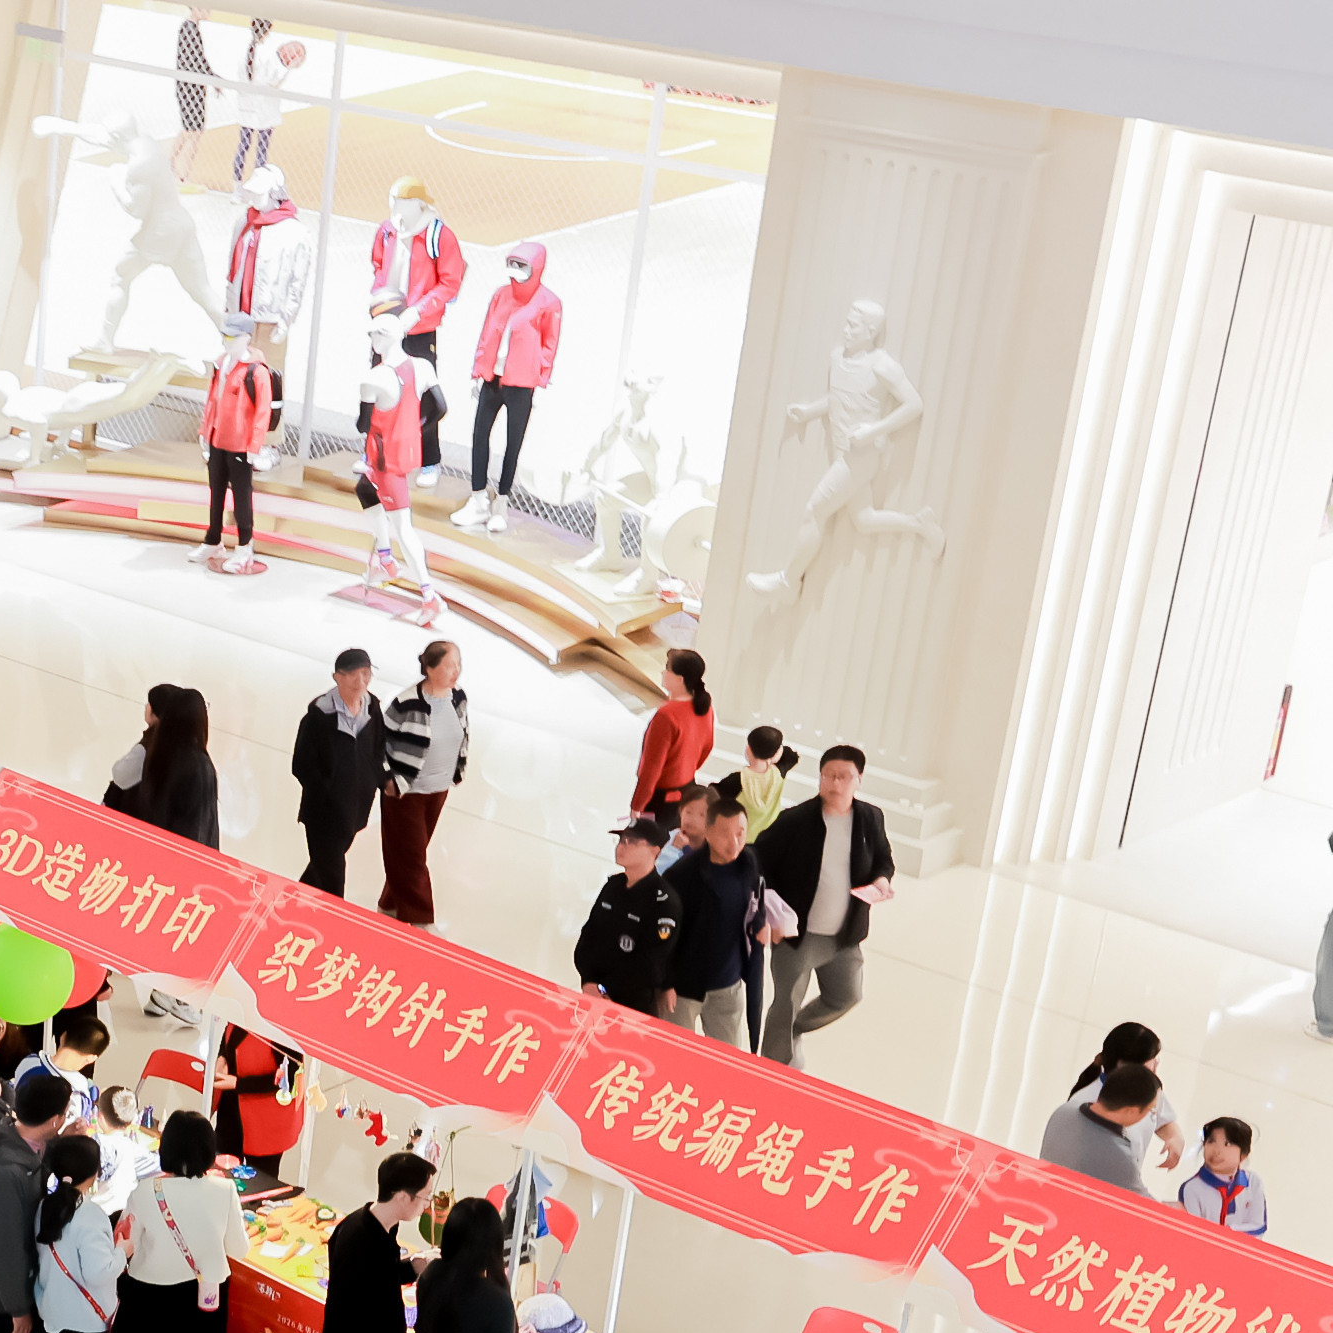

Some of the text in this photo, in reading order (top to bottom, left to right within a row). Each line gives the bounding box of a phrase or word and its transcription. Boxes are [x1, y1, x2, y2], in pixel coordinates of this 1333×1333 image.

[258, 930, 541, 1084] 织梦钩针手作
[584, 1059, 920, 1236] 传统编绳手作
